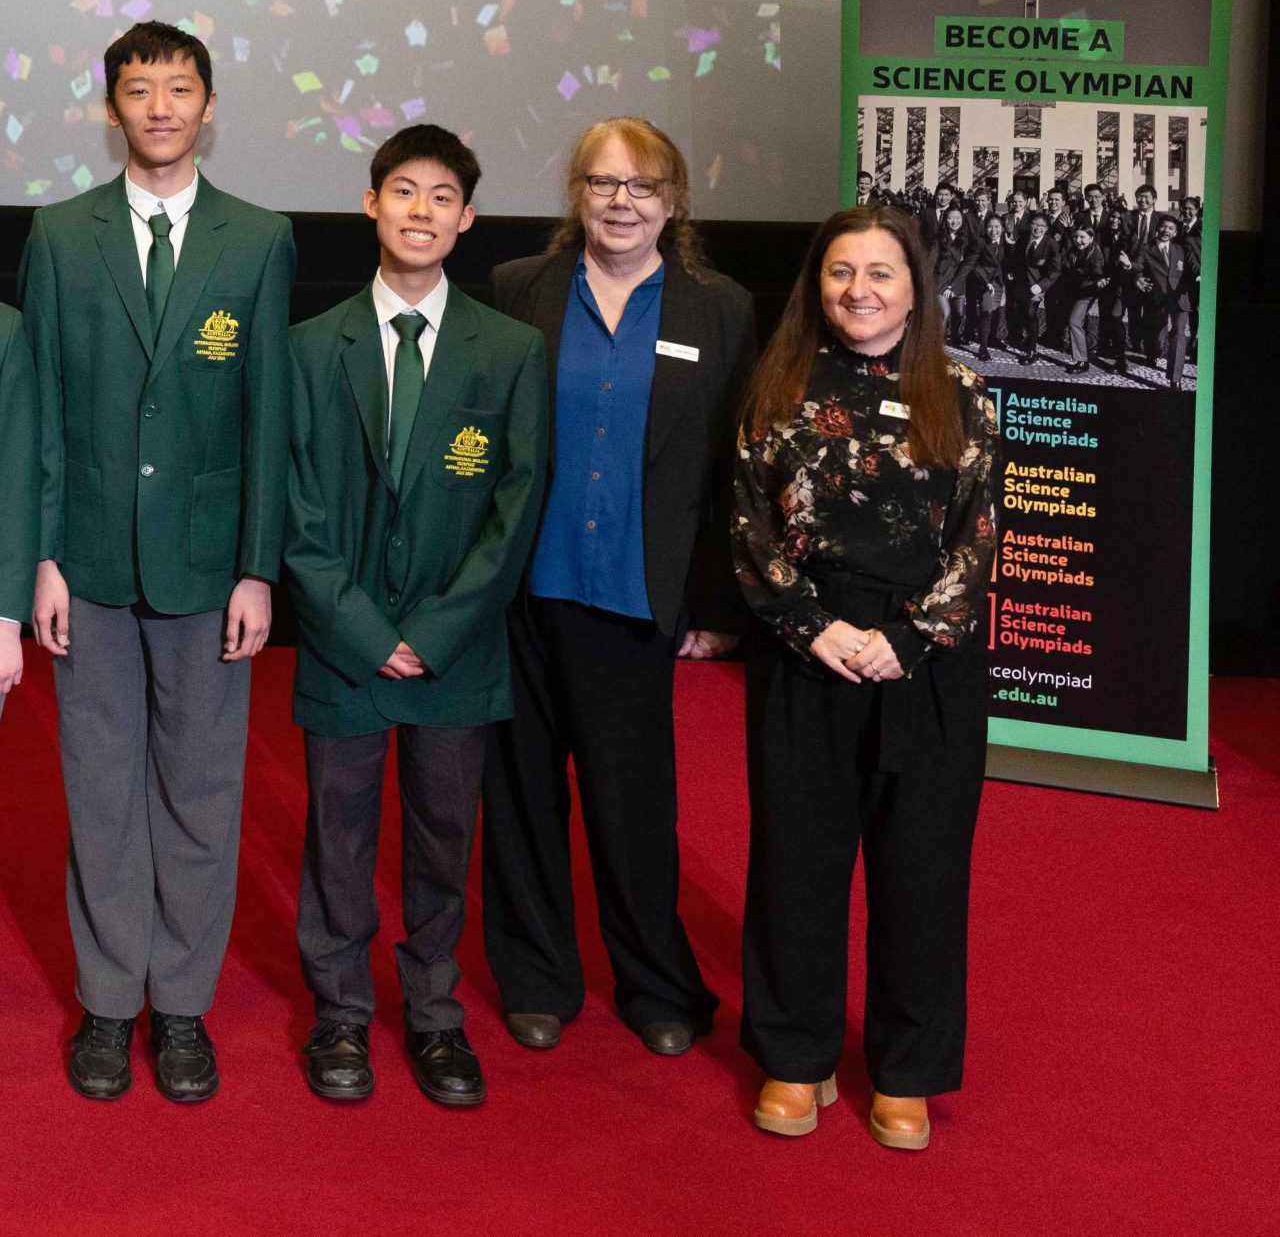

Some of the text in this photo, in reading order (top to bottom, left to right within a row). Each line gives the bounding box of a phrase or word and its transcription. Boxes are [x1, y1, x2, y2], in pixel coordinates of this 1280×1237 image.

[946, 25, 1112, 52] BECOME A
[873, 66, 1193, 99] SCIENCE OLYMPIAN
[1006, 393, 1098, 414] Australian
[1005, 410, 1072, 428] Science
[1005, 426, 1099, 448] Olympiads
[1004, 462, 1096, 484] Australian
[1004, 478, 1070, 498] Science
[1003, 495, 1096, 517] Olympiads
[1002, 530, 1094, 553] Australian
[1002, 547, 1068, 566] Science
[1001, 563, 1094, 586] Olympiads
[1001, 598, 1092, 621] Australian
[1000, 614, 1066, 635] Science
[1000, 631, 1092, 655] Olympiads
[989, 666, 1092, 689] ceolympiad
